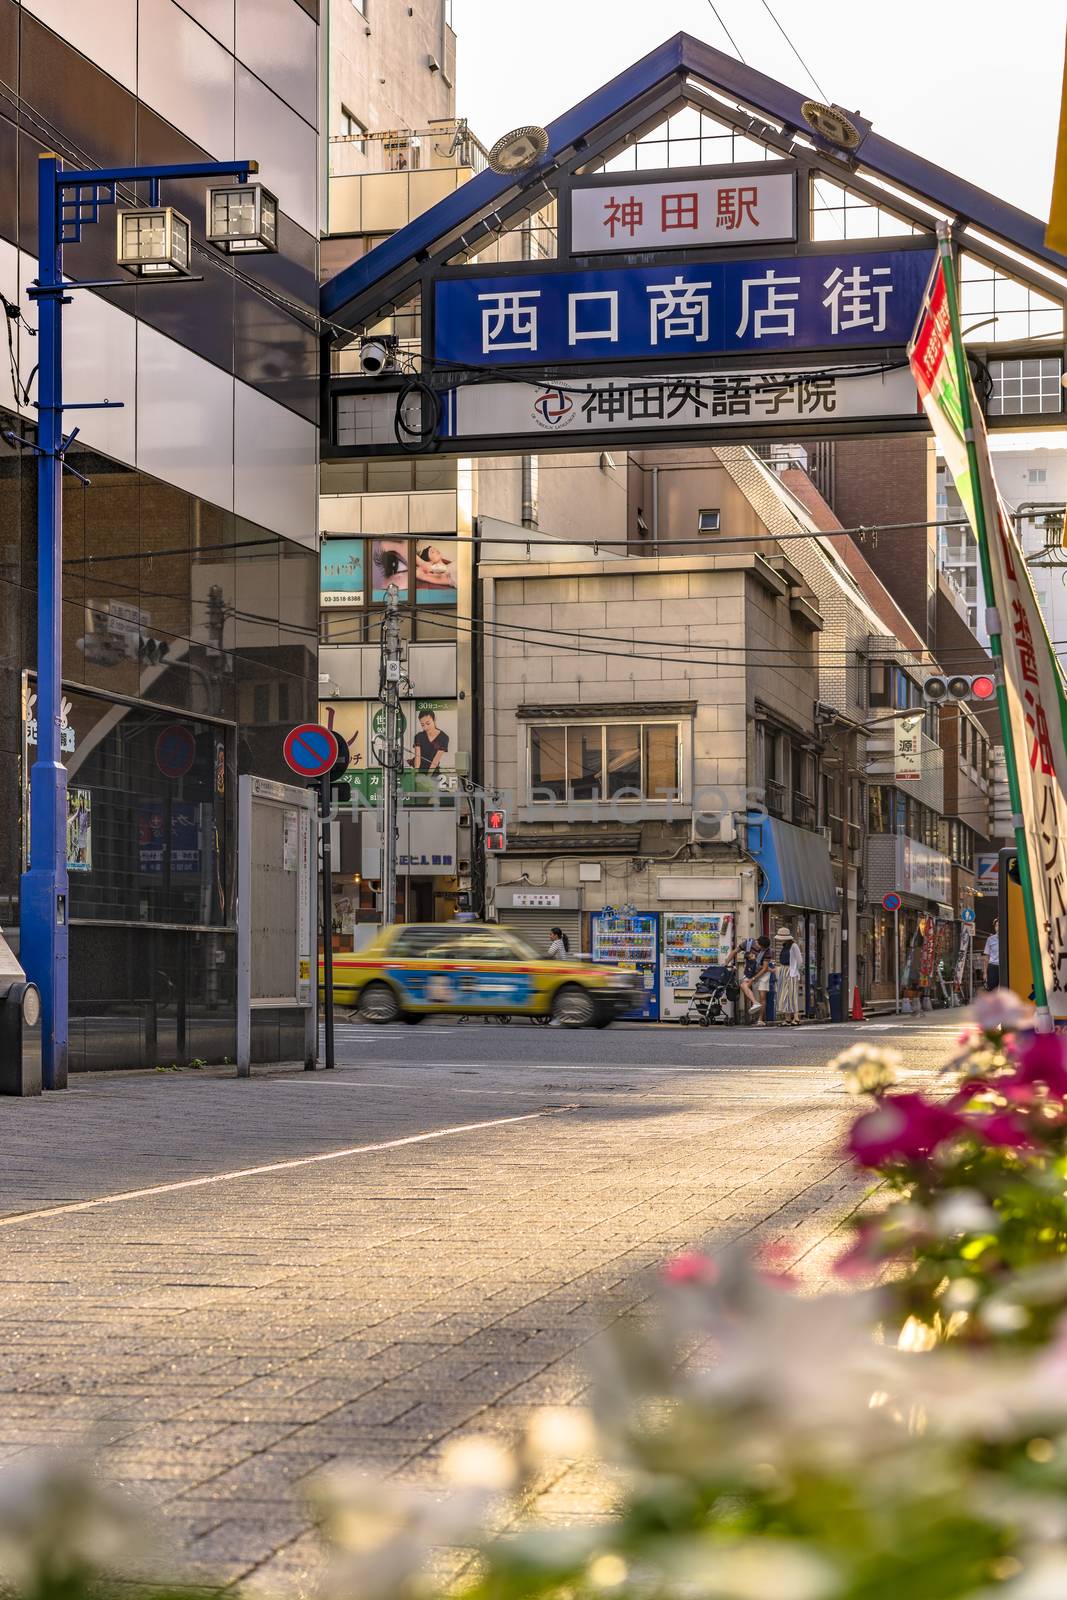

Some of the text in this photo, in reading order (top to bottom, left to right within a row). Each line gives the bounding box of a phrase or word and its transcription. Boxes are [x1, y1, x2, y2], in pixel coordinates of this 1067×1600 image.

[603, 186, 760, 239] 神田駅
[477, 265, 894, 355] 西口商店街
[580, 369, 837, 425] 神田外語学院
[438, 774, 458, 790] 2F
